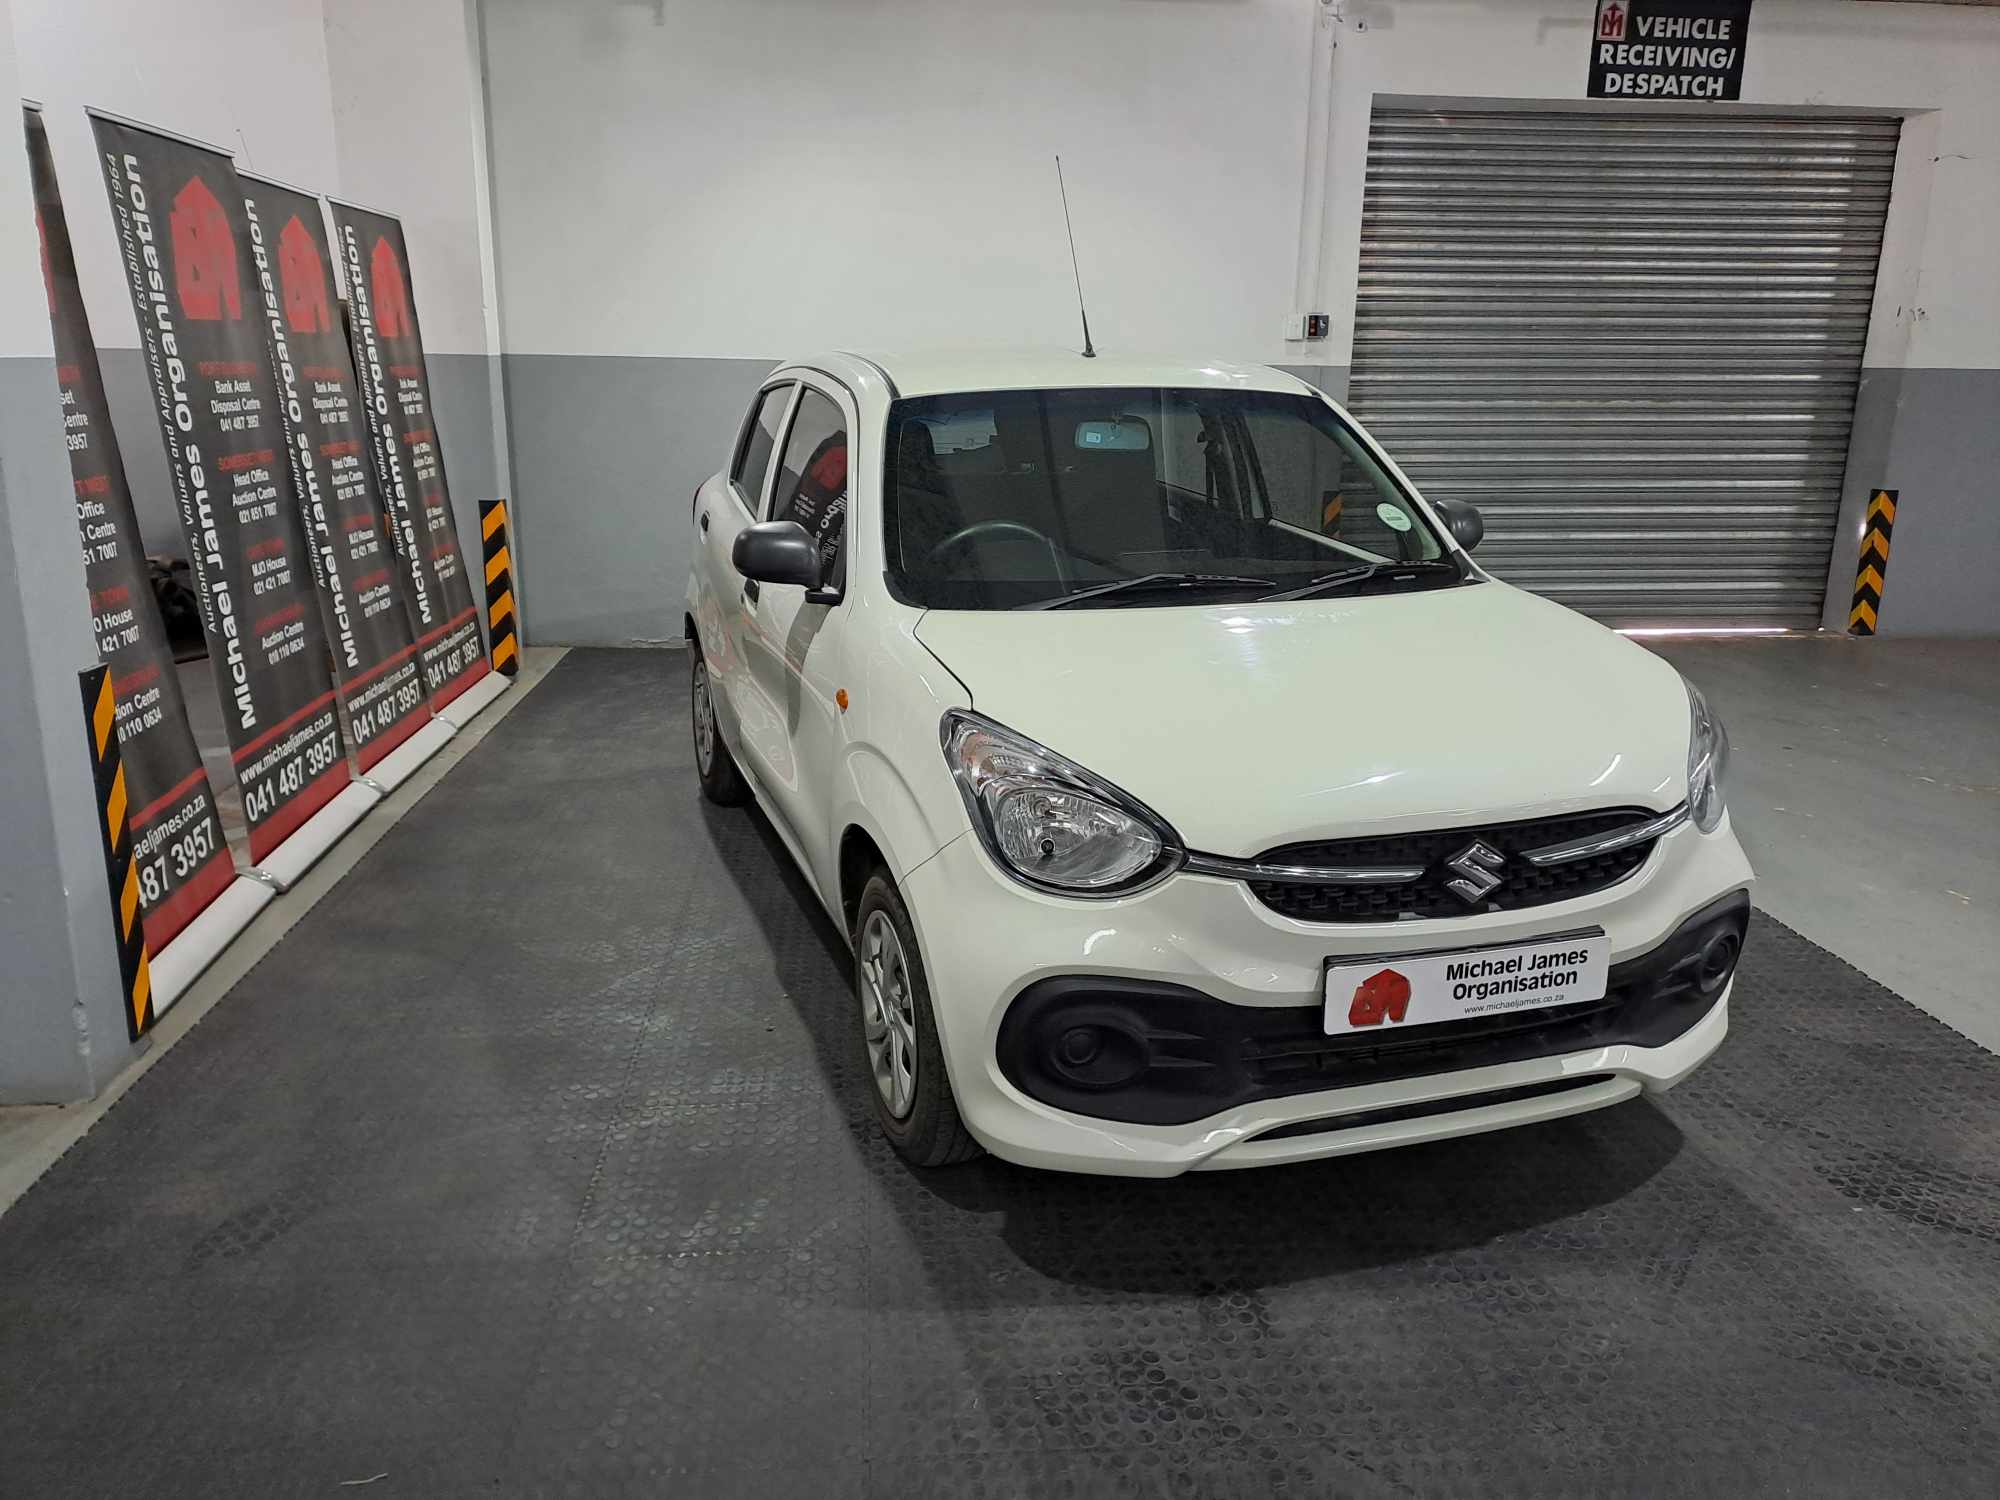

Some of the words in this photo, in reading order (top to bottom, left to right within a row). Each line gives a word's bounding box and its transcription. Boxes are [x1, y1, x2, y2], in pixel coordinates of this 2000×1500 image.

[1635, 15, 1733, 40] VEHICLE
[1599, 43, 1737, 69] RECEIVING/
[1604, 72, 1725, 97] DESPATCH
[106, 152, 124, 199] 1964
[116, 203, 148, 312] Established
[123, 153, 193, 433] Organisation
[244, 198, 303, 424] Organisation
[344, 224, 388, 416] Organisation
[144, 326, 171, 422] Appraisers
[214, 379, 233, 394] Bank
[210, 399, 241, 415] Disposal
[65, 433, 88, 450] 3957
[164, 423, 179, 459] and
[176, 462, 195, 526] Valuers
[296, 432, 329, 537] James
[382, 423, 410, 513] James
[86, 521, 117, 541] Centre
[185, 443, 224, 571] James
[96, 541, 118, 561] 7007
[266, 556, 286, 572] House
[400, 519, 433, 625] Michael
[102, 607, 134, 629] House
[319, 545, 360, 669] Michael
[101, 634, 120, 653] 421
[120, 625, 140, 644] 7007
[215, 580, 257, 730] Michael
[262, 629, 284, 650] Auction
[427, 658, 447, 689] 041
[446, 651, 462, 677] 487
[463, 636, 481, 667] 3957
[133, 687, 161, 710] Centre
[348, 661, 416, 714] www.michaeljames.co.za
[353, 711, 377, 745] 041
[377, 696, 397, 728] 487
[398, 678, 421, 715] 3957
[239, 711, 334, 785] www.michaeljames.co.za
[245, 781, 275, 823] 041
[278, 759, 305, 797] 487
[305, 730, 338, 776] 3957
[133, 793, 206, 860] aeljames.co.za
[170, 816, 215, 878] 3957
[1446, 955, 1523, 982] Michael
[1527, 949, 1588, 972] James
[1453, 970, 1578, 1001] Organisation
[1464, 993, 1565, 1015] www.michaeljames.co.za
